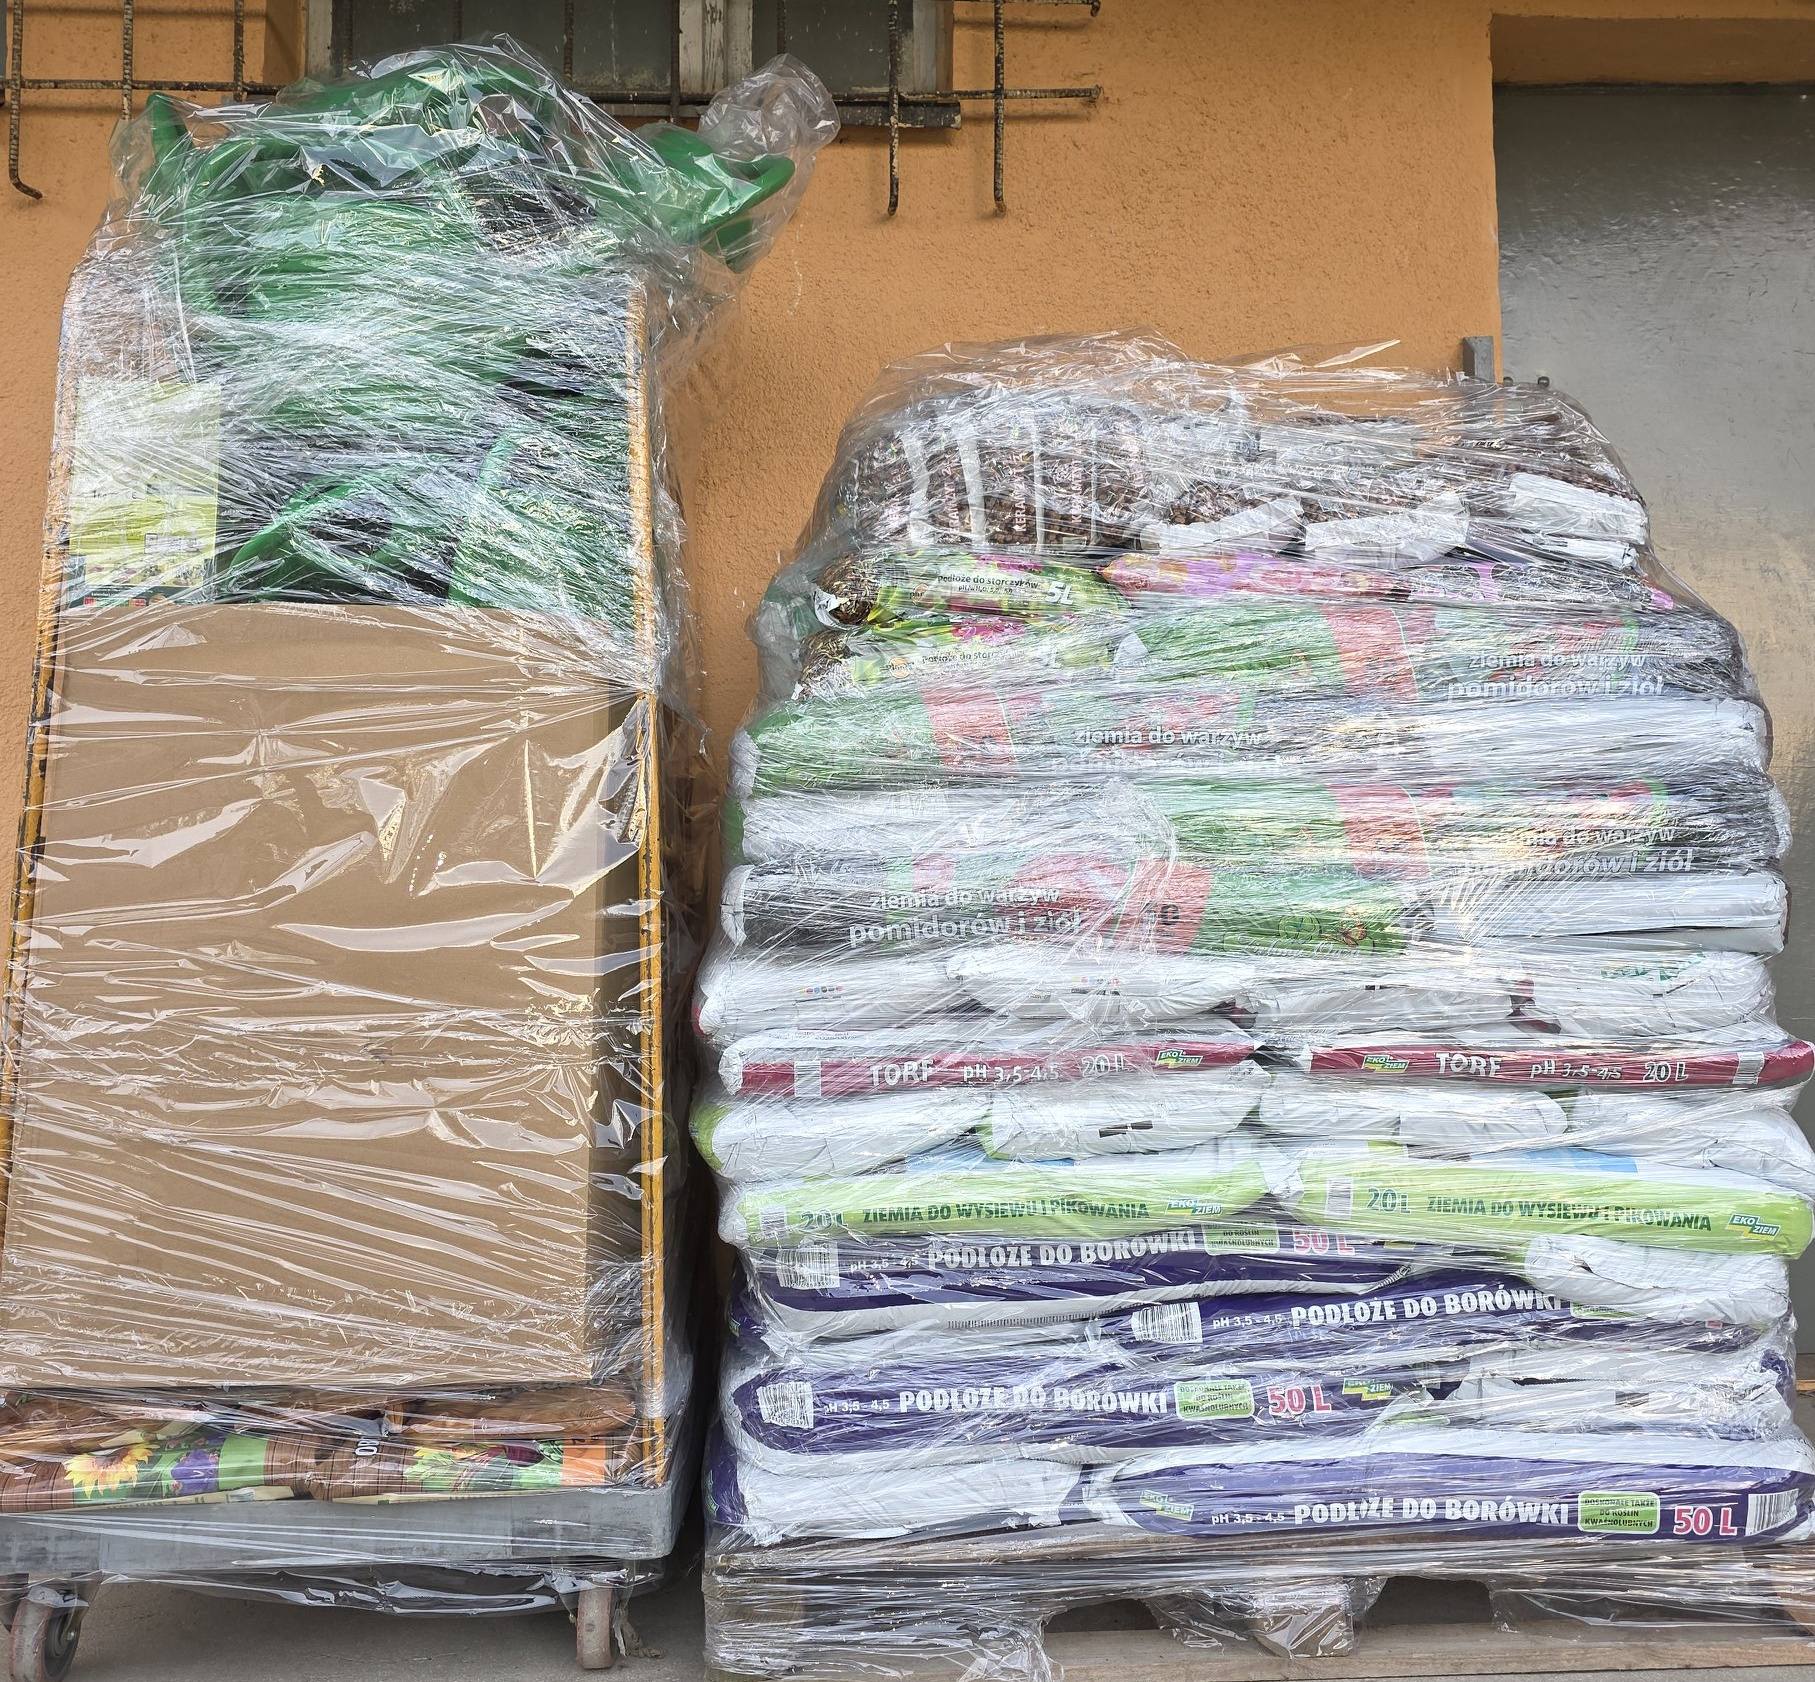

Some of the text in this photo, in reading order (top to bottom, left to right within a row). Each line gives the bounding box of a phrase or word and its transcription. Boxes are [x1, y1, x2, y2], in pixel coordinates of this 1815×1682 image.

[973, 575, 985, 584] do
[1469, 653, 1645, 671] ziemia do warzyw
[1072, 726, 1262, 749] ziemia do warzyw
[870, 887, 1060, 909] ziemia do warzyw
[849, 908, 1082, 947] pomidorów i ziół
[869, 1060, 934, 1086] TORF
[963, 1063, 989, 1083] pH
[1081, 1054, 1110, 1078] 20
[1177, 1057, 1200, 1065] ZIEM
[1366, 1055, 1386, 1064] EKO
[1383, 1062, 1407, 1070] ZIEM
[1434, 1053, 1503, 1077] TORF
[1529, 1060, 1556, 1079] pH
[1643, 1061, 1672, 1083] 20
[862, 1207, 924, 1223] ZIEMIA
[927, 1205, 951, 1220] DO
[955, 1201, 1038, 1218] WYSIEWU
[1049, 1200, 1151, 1219] PIKOWANIA
[1170, 1200, 1194, 1208] EKO
[1195, 1205, 1222, 1215] ZIEM
[1427, 1196, 1487, 1216] ZIEMIA
[1490, 1200, 1514, 1216] DO
[1613, 1207, 1712, 1231] PIKOWANIA
[1732, 1215, 1757, 1225] EKO
[1752, 1225, 1778, 1236] ZIEM
[1292, 1230, 1356, 1256] 50 L
[1038, 1244, 1073, 1266] DO
[1212, 1315, 1230, 1330] pH
[1233, 1315, 1253, 1328] 3,5
[1263, 1314, 1283, 1326] 4,5
[1402, 1296, 1438, 1319] DO
[841, 1401, 860, 1414] 3,5
[871, 1399, 890, 1412] 4,5
[1012, 1386, 1047, 1408] DO
[1266, 1383, 1333, 1415] 50 L
[1211, 1514, 1230, 1526] pH
[1233, 1513, 1253, 1525] 3,5
[1264, 1512, 1286, 1524] 4,5
[1402, 1497, 1438, 1520] DO
[1444, 1495, 1570, 1525] BORÓWKI
[1599, 1508, 1640, 1517] DO ROŚLIN
[1673, 1505, 1738, 1536] 50 L
[1583, 1517, 1654, 1528] KWAŚNOLUBNYCH
